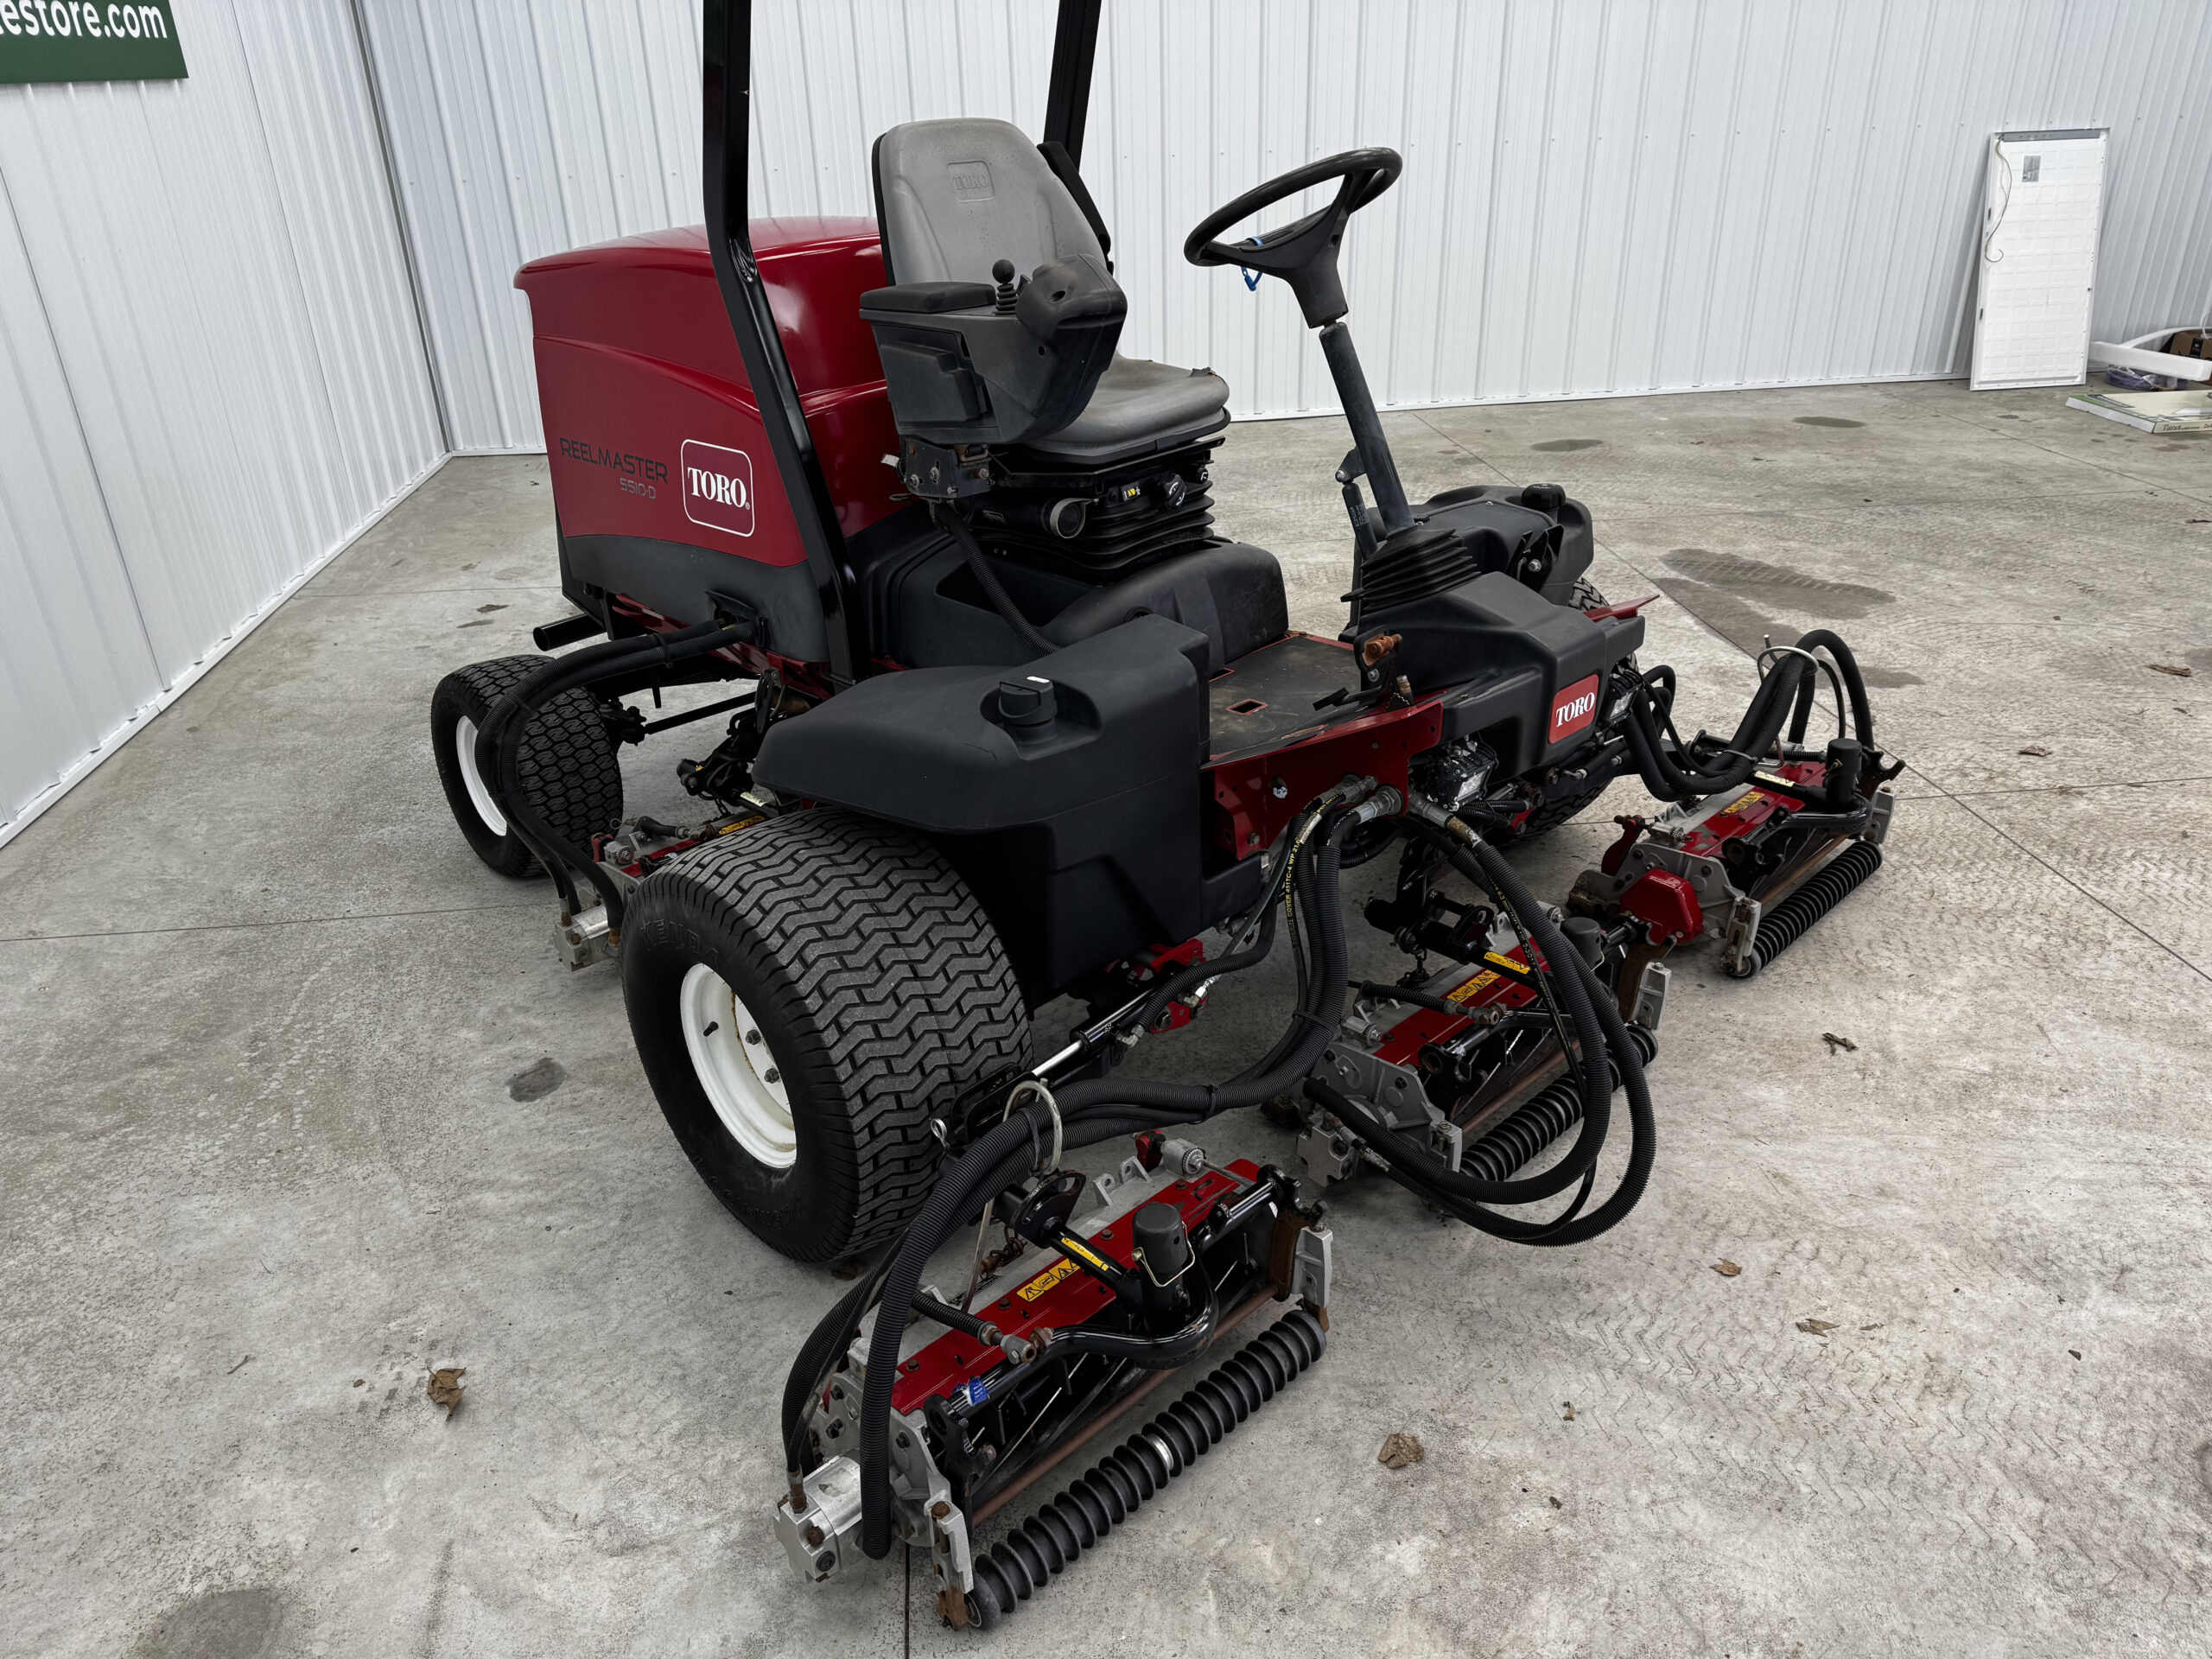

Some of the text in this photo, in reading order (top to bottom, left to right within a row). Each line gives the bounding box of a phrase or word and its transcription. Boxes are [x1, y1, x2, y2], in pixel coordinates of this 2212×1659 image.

[0, 0, 168, 39] estore.com
[952, 173, 988, 190] TORO
[560, 437, 668, 484] REELMASTER
[1556, 692, 1596, 728] TORO
[639, 918, 720, 973] KENDA
